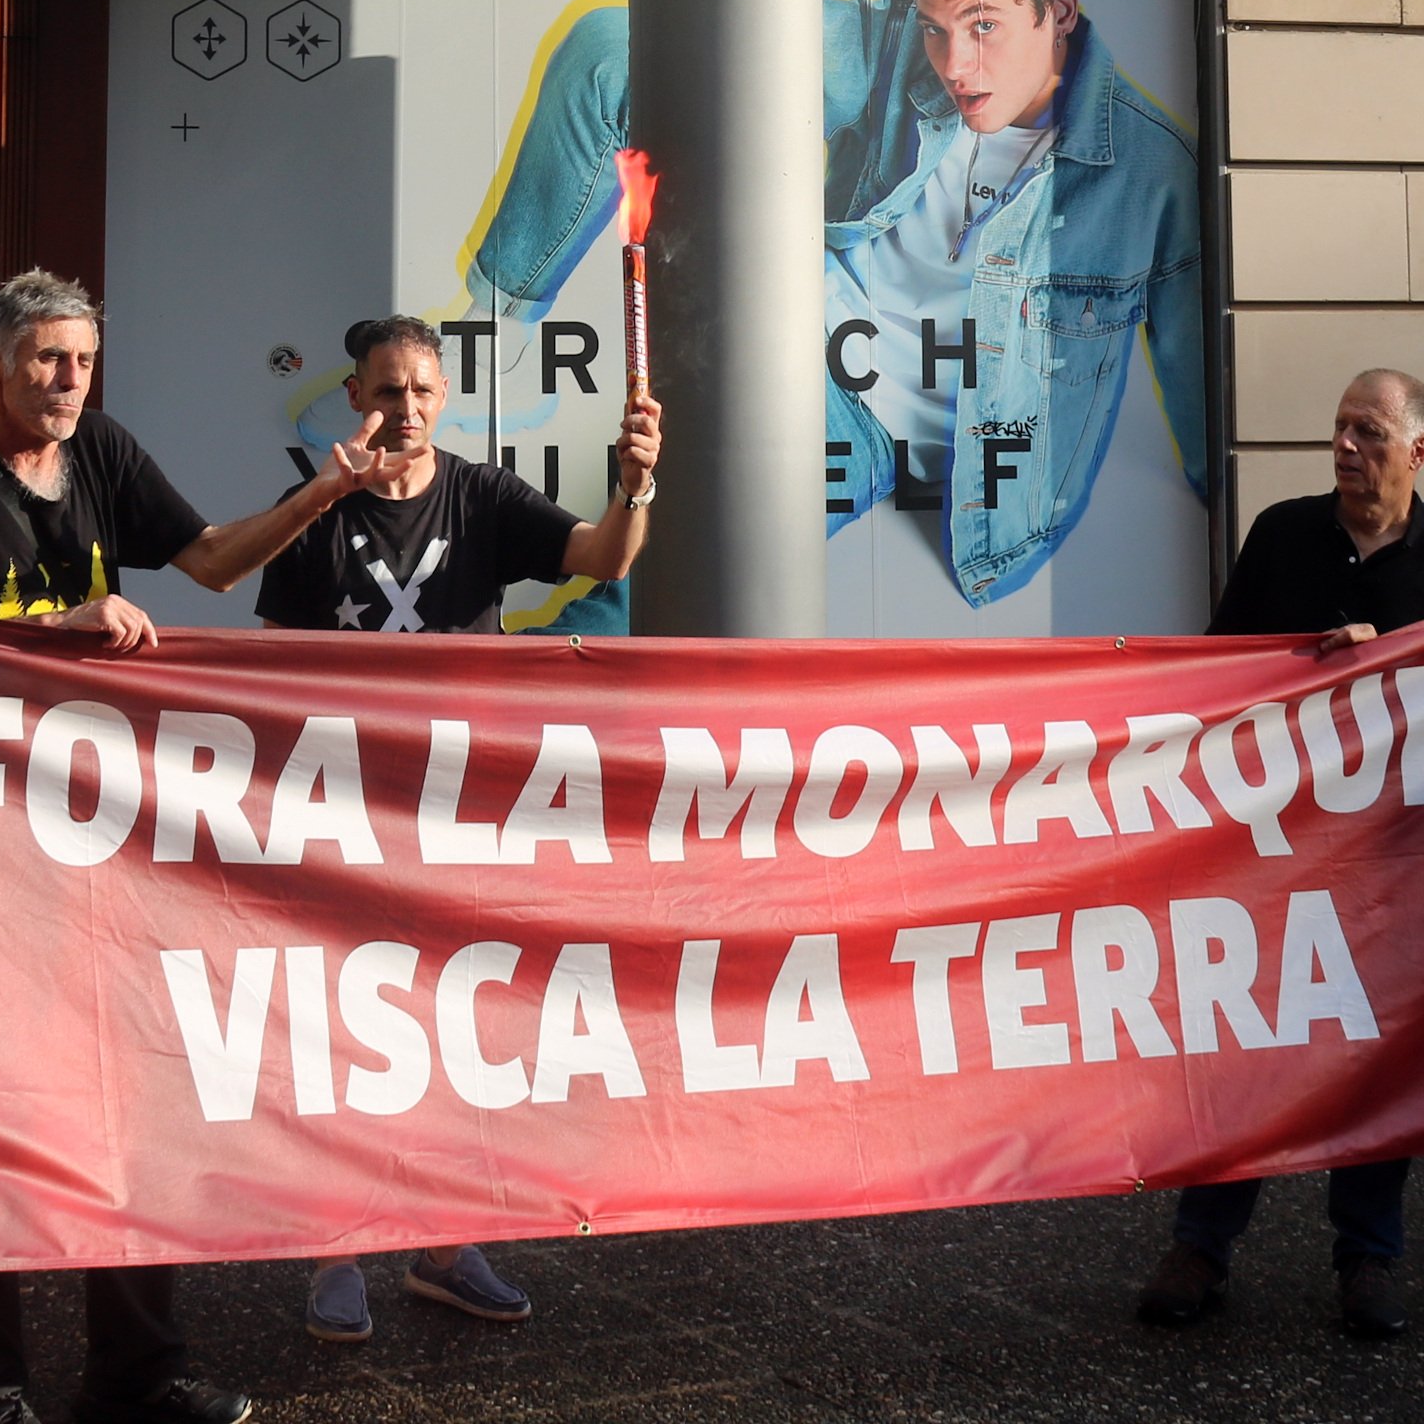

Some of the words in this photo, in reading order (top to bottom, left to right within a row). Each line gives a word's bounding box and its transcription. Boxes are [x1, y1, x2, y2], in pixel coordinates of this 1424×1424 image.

[417, 719, 613, 865] LA
[159, 940, 648, 1122] VISCA
[674, 933, 870, 1094] LA
[890, 889, 1381, 1076] TERRA
